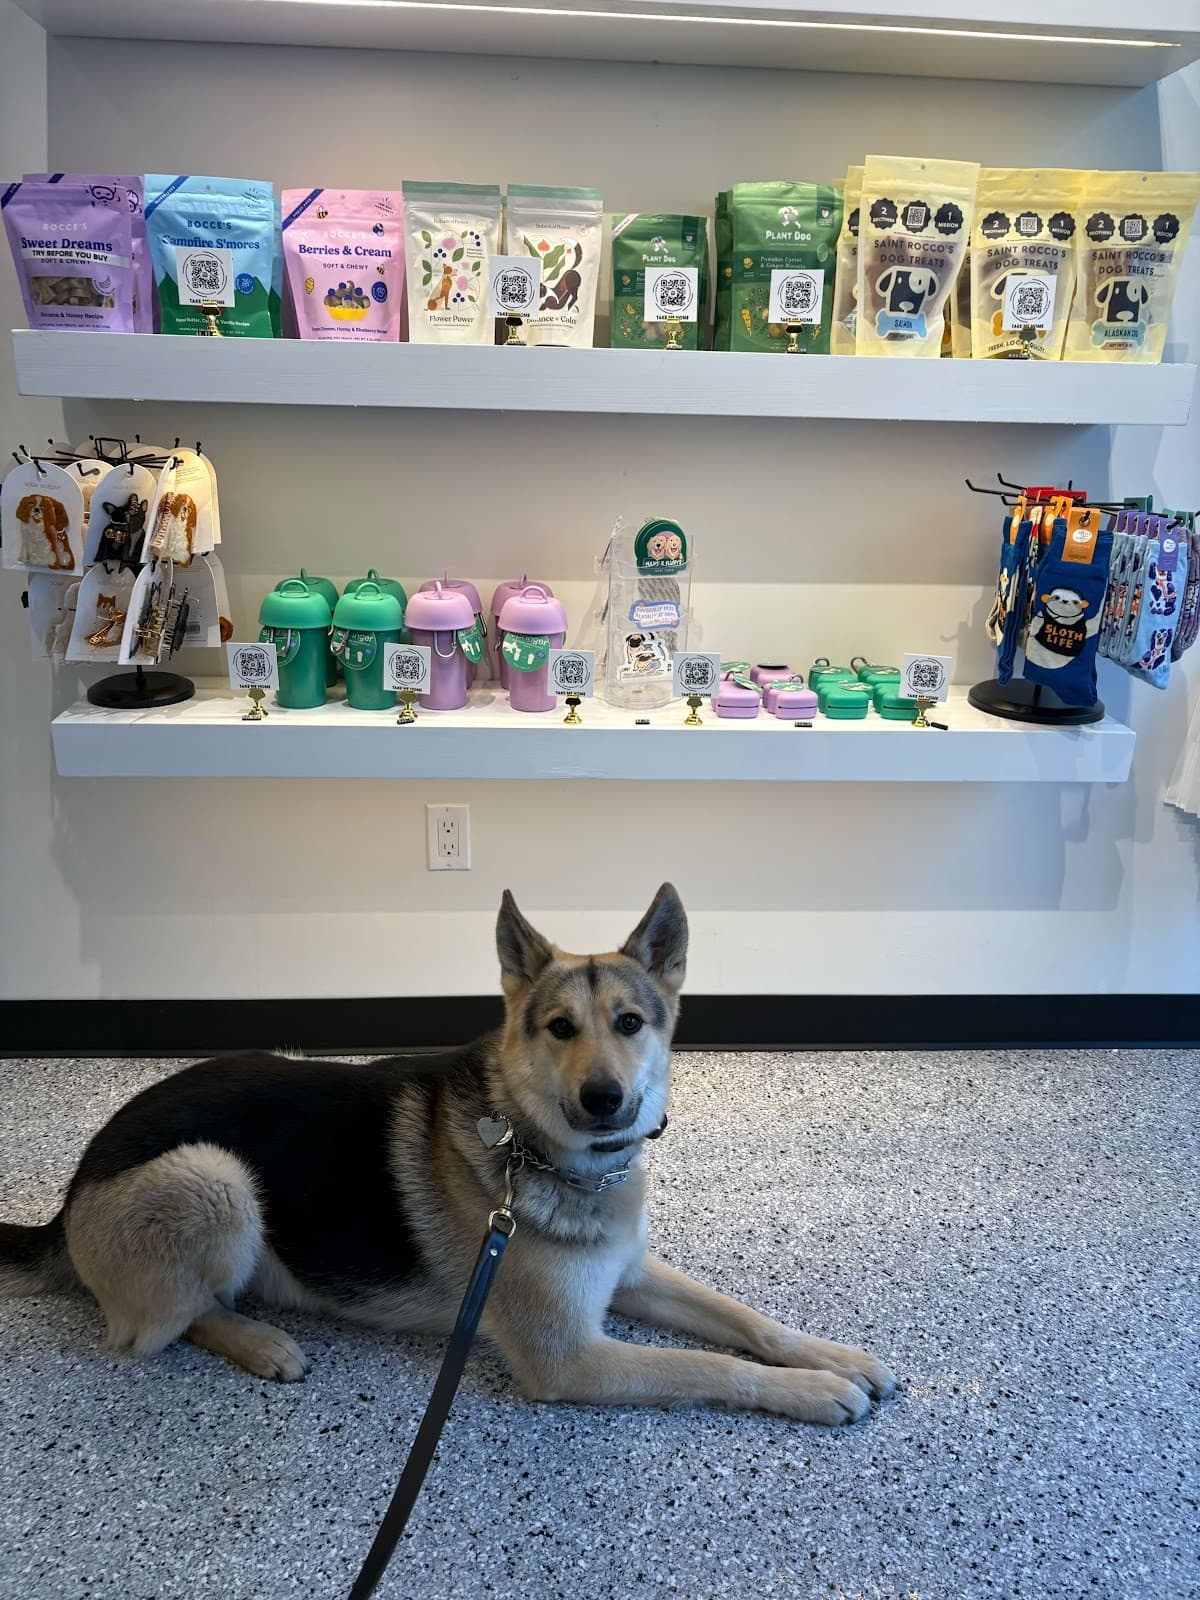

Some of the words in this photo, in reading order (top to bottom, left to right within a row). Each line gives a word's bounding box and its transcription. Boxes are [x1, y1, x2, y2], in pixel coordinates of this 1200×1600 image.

[881, 207, 888, 216] 2
[188, 220, 232, 230] BOCCE'S
[993, 220, 999, 228] 2
[1098, 220, 1104, 228] 2
[21, 237, 58, 249] Sweet
[61, 238, 113, 252] Dreams
[162, 234, 214, 248] Campfire
[216, 238, 260, 250] S'mores
[874, 239, 904, 250] SAINT
[907, 242, 954, 254] ROCCO'S
[46, 250, 73, 258] BEFORE
[75, 250, 91, 259] YOU
[93, 253, 108, 262] BUY
[298, 244, 340, 255] Berries
[342, 245, 352, 255] &
[354, 246, 392, 258] Cream
[987, 246, 1019, 257] SAINT
[1022, 246, 1066, 258] ROCCO'S
[1092, 251, 1121, 262] SAINT
[1126, 251, 1165, 262] ROCCO'S
[880, 254, 904, 264] DOG
[908, 256, 945, 268] TREATS
[995, 258, 1020, 270] DOG
[1025, 259, 1058, 270] TREATS
[1099, 266, 1122, 275] DOG
[1128, 266, 1154, 276] TREATS
[560, 316, 577, 324] Calm
[1104, 329, 1130, 337] ALASKAN
[1045, 624, 1083, 640] SLOTH
[1046, 634, 1074, 648] LIFE
